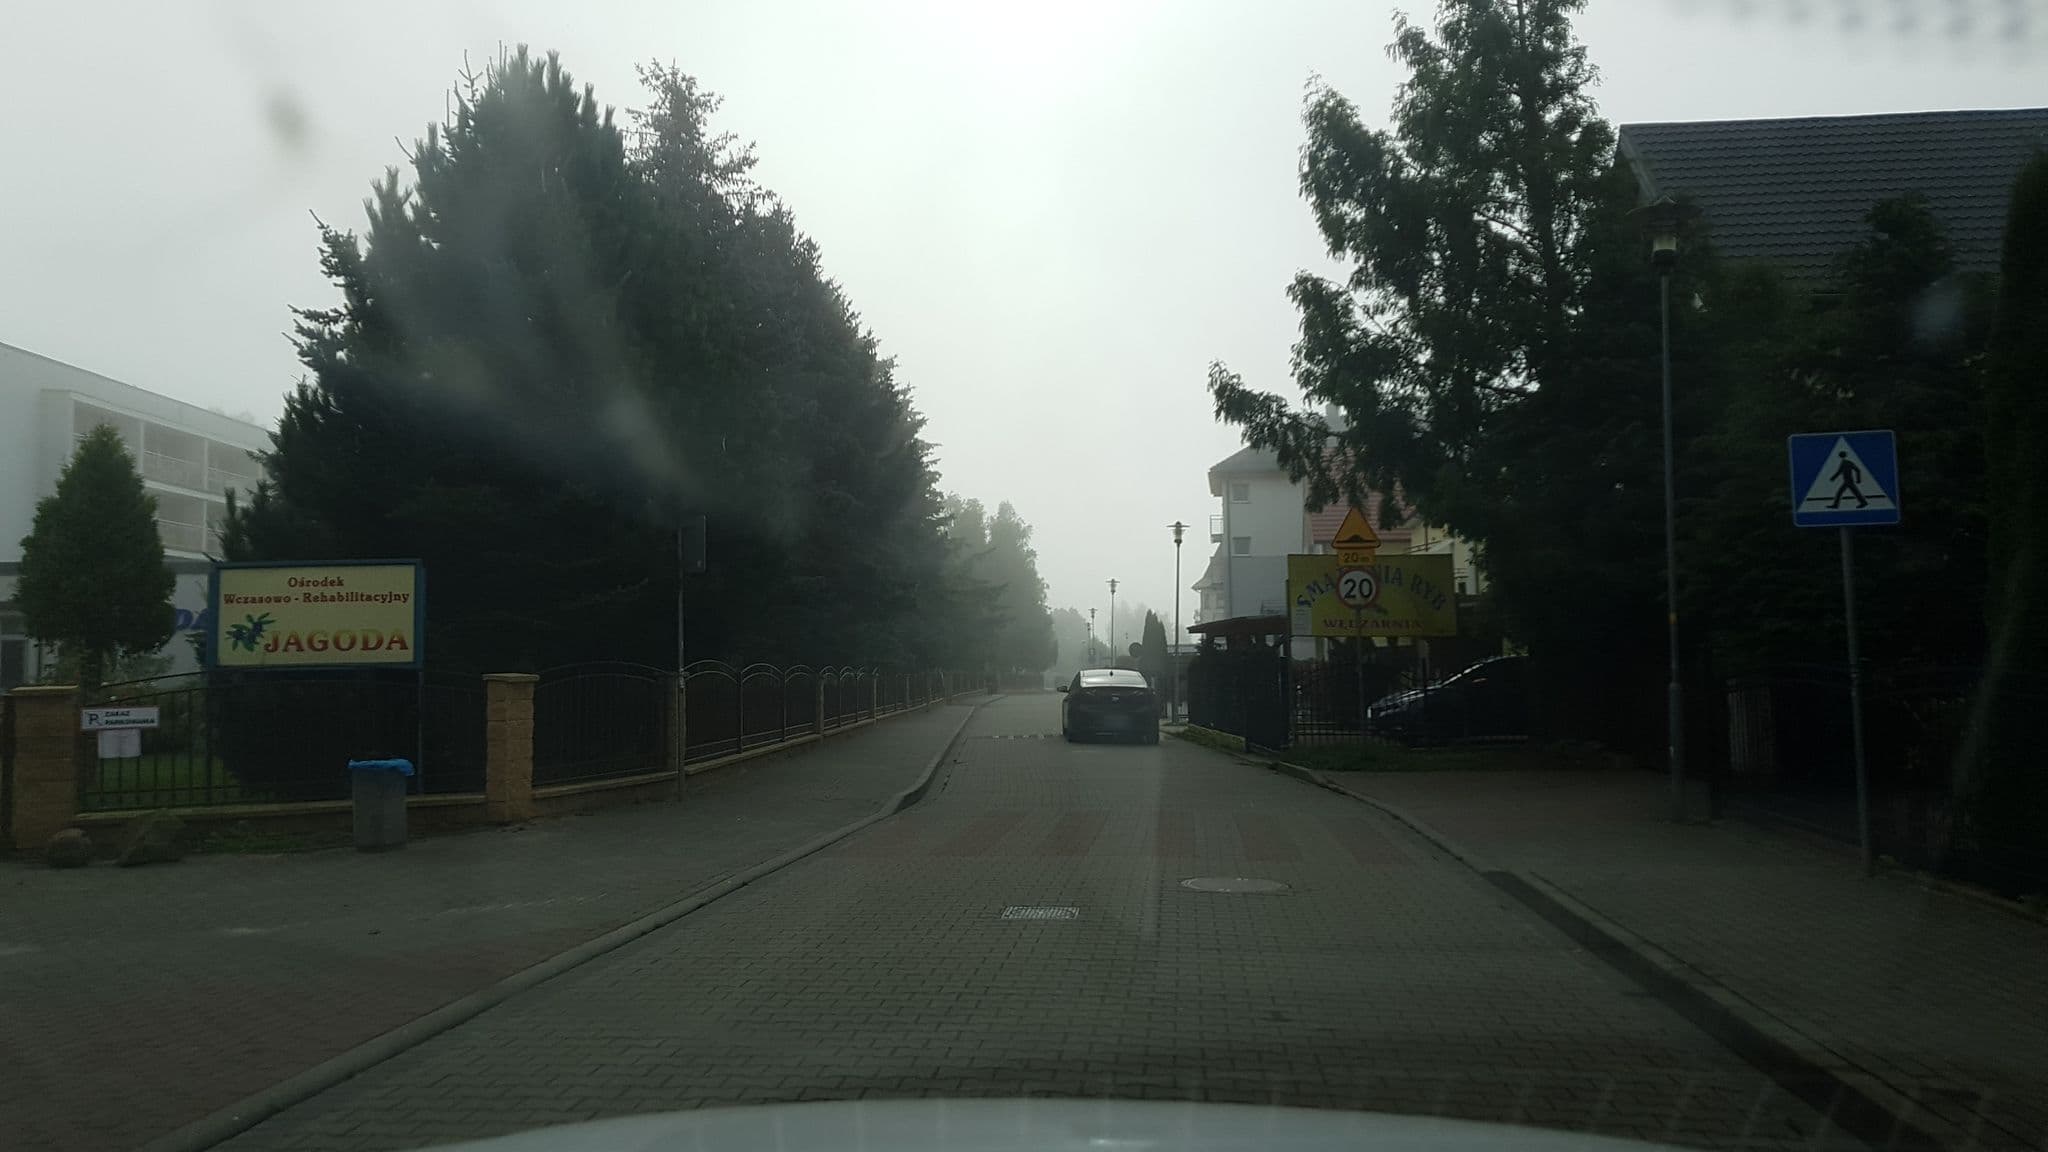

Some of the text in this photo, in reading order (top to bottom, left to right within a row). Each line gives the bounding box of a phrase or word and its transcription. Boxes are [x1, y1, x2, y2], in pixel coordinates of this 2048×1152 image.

[1344, 552, 1359, 563] 20
[288, 576, 344, 588] Ośrodek
[1344, 578, 1372, 599] 20
[224, 593, 290, 605] Wczasowo
[303, 591, 410, 604] Rehabilitacyjny
[1412, 573, 1446, 611] RYB
[264, 627, 409, 653] JAGODA
